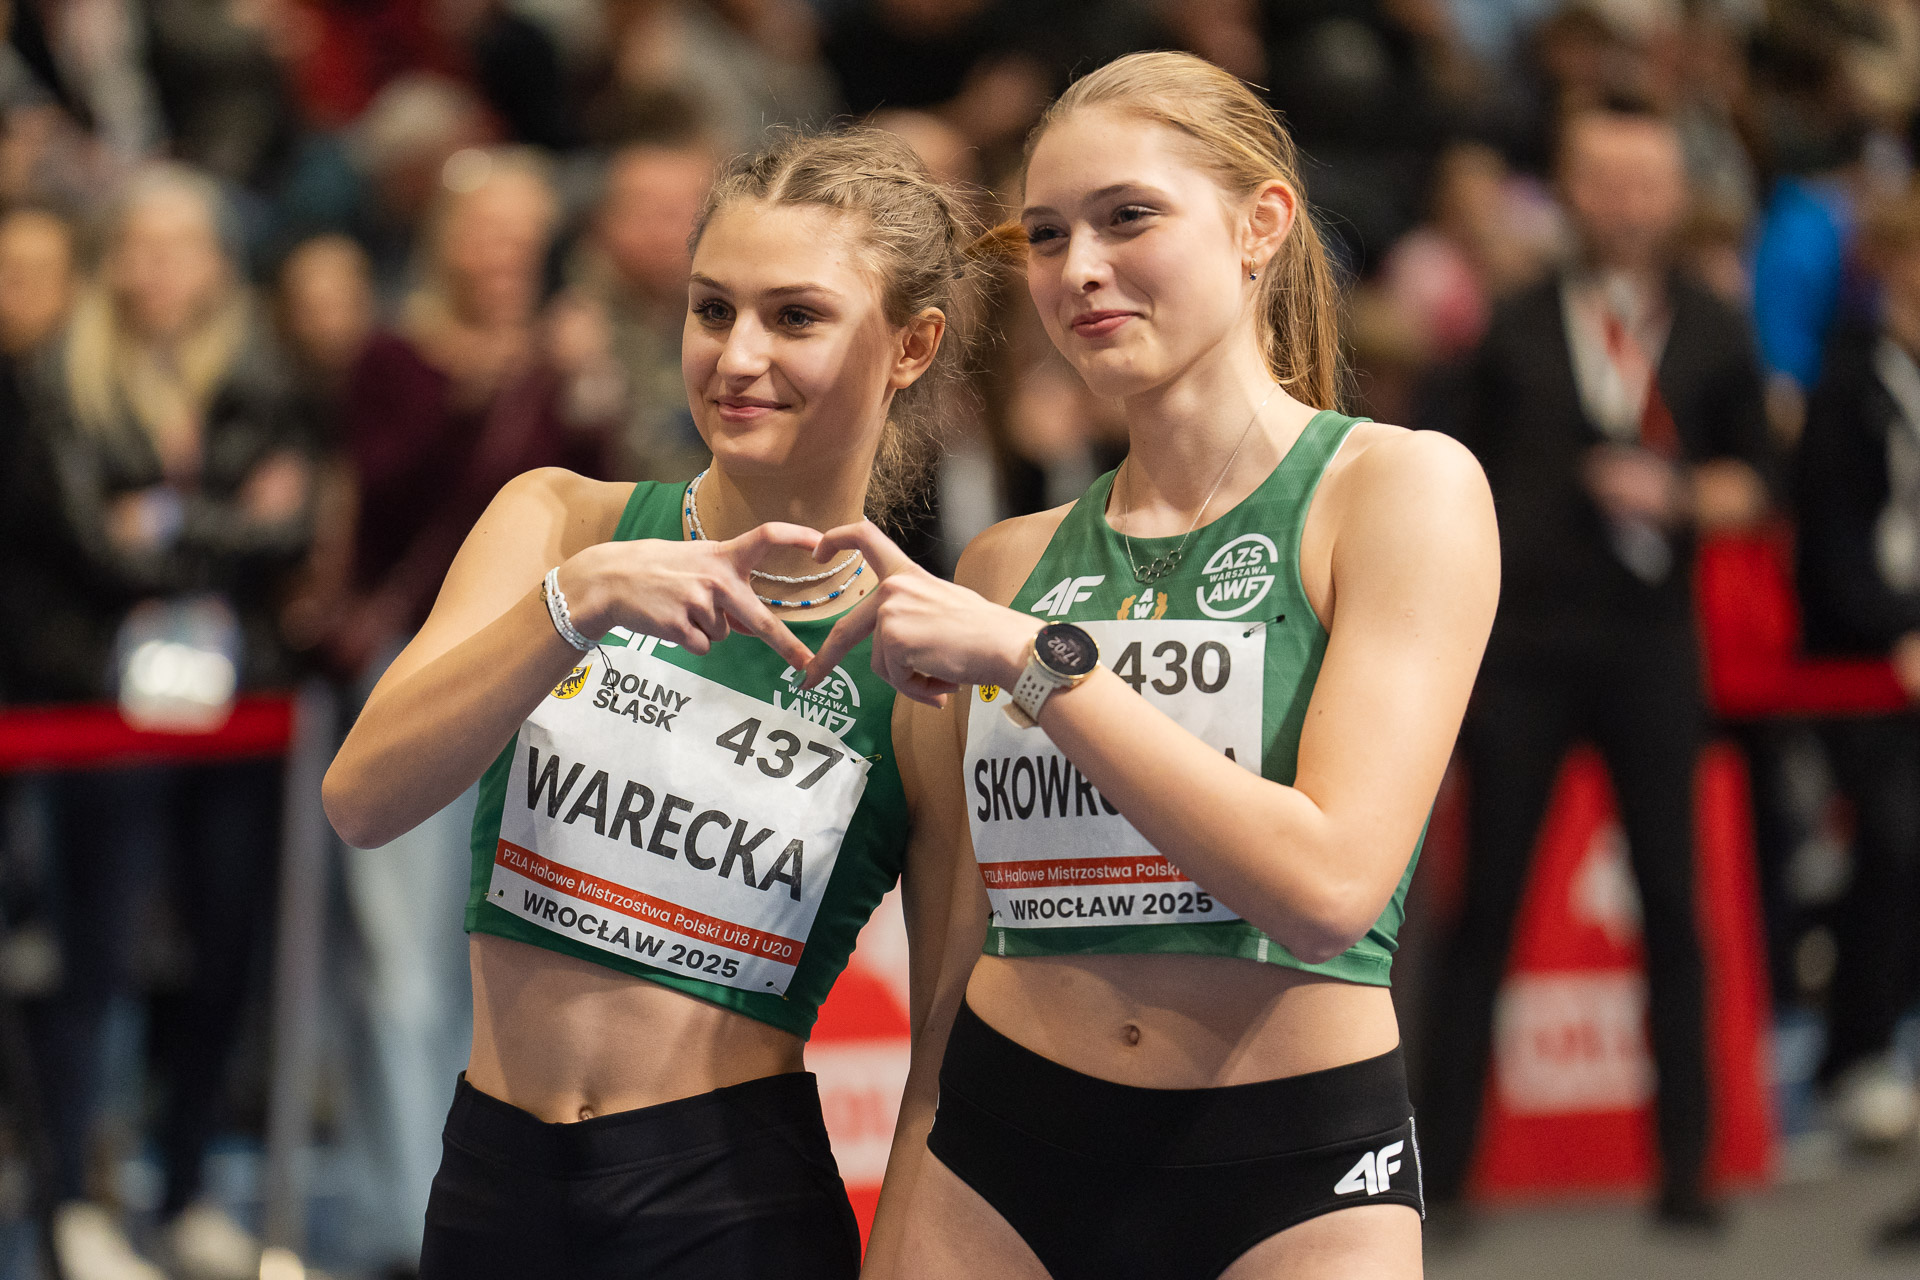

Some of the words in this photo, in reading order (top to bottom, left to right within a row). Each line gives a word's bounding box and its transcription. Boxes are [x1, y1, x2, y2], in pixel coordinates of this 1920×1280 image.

[1210, 566, 1267, 583] WARSZAWA
[1221, 547, 1264, 569] AZS
[1031, 575, 1106, 616] 4F
[1206, 576, 1260, 604] AWF
[1112, 640, 1231, 696] 430
[593, 687, 678, 732] ŚLĄSK
[601, 669, 692, 713] DOLNY
[788, 684, 848, 714] WARSZAWA
[716, 717, 844, 790] 437
[527, 746, 804, 902] WARECKA
[1005, 868, 1045, 882] Halowe
[1047, 864, 1132, 880] Mistrzostwa
[503, 848, 528, 871] PZLA
[530, 860, 576, 889] Halowe
[578, 880, 671, 922] Mistrzostwa
[674, 913, 721, 938] Polski
[723, 929, 750, 947] U18
[752, 937, 760, 949] i
[761, 943, 792, 958] U20
[1009, 895, 1135, 920] WROCŁAW
[1142, 892, 1213, 915] 2025
[523, 889, 666, 958] WROCŁAW
[667, 943, 740, 978] 2025
[1333, 1139, 1404, 1196] 4F
